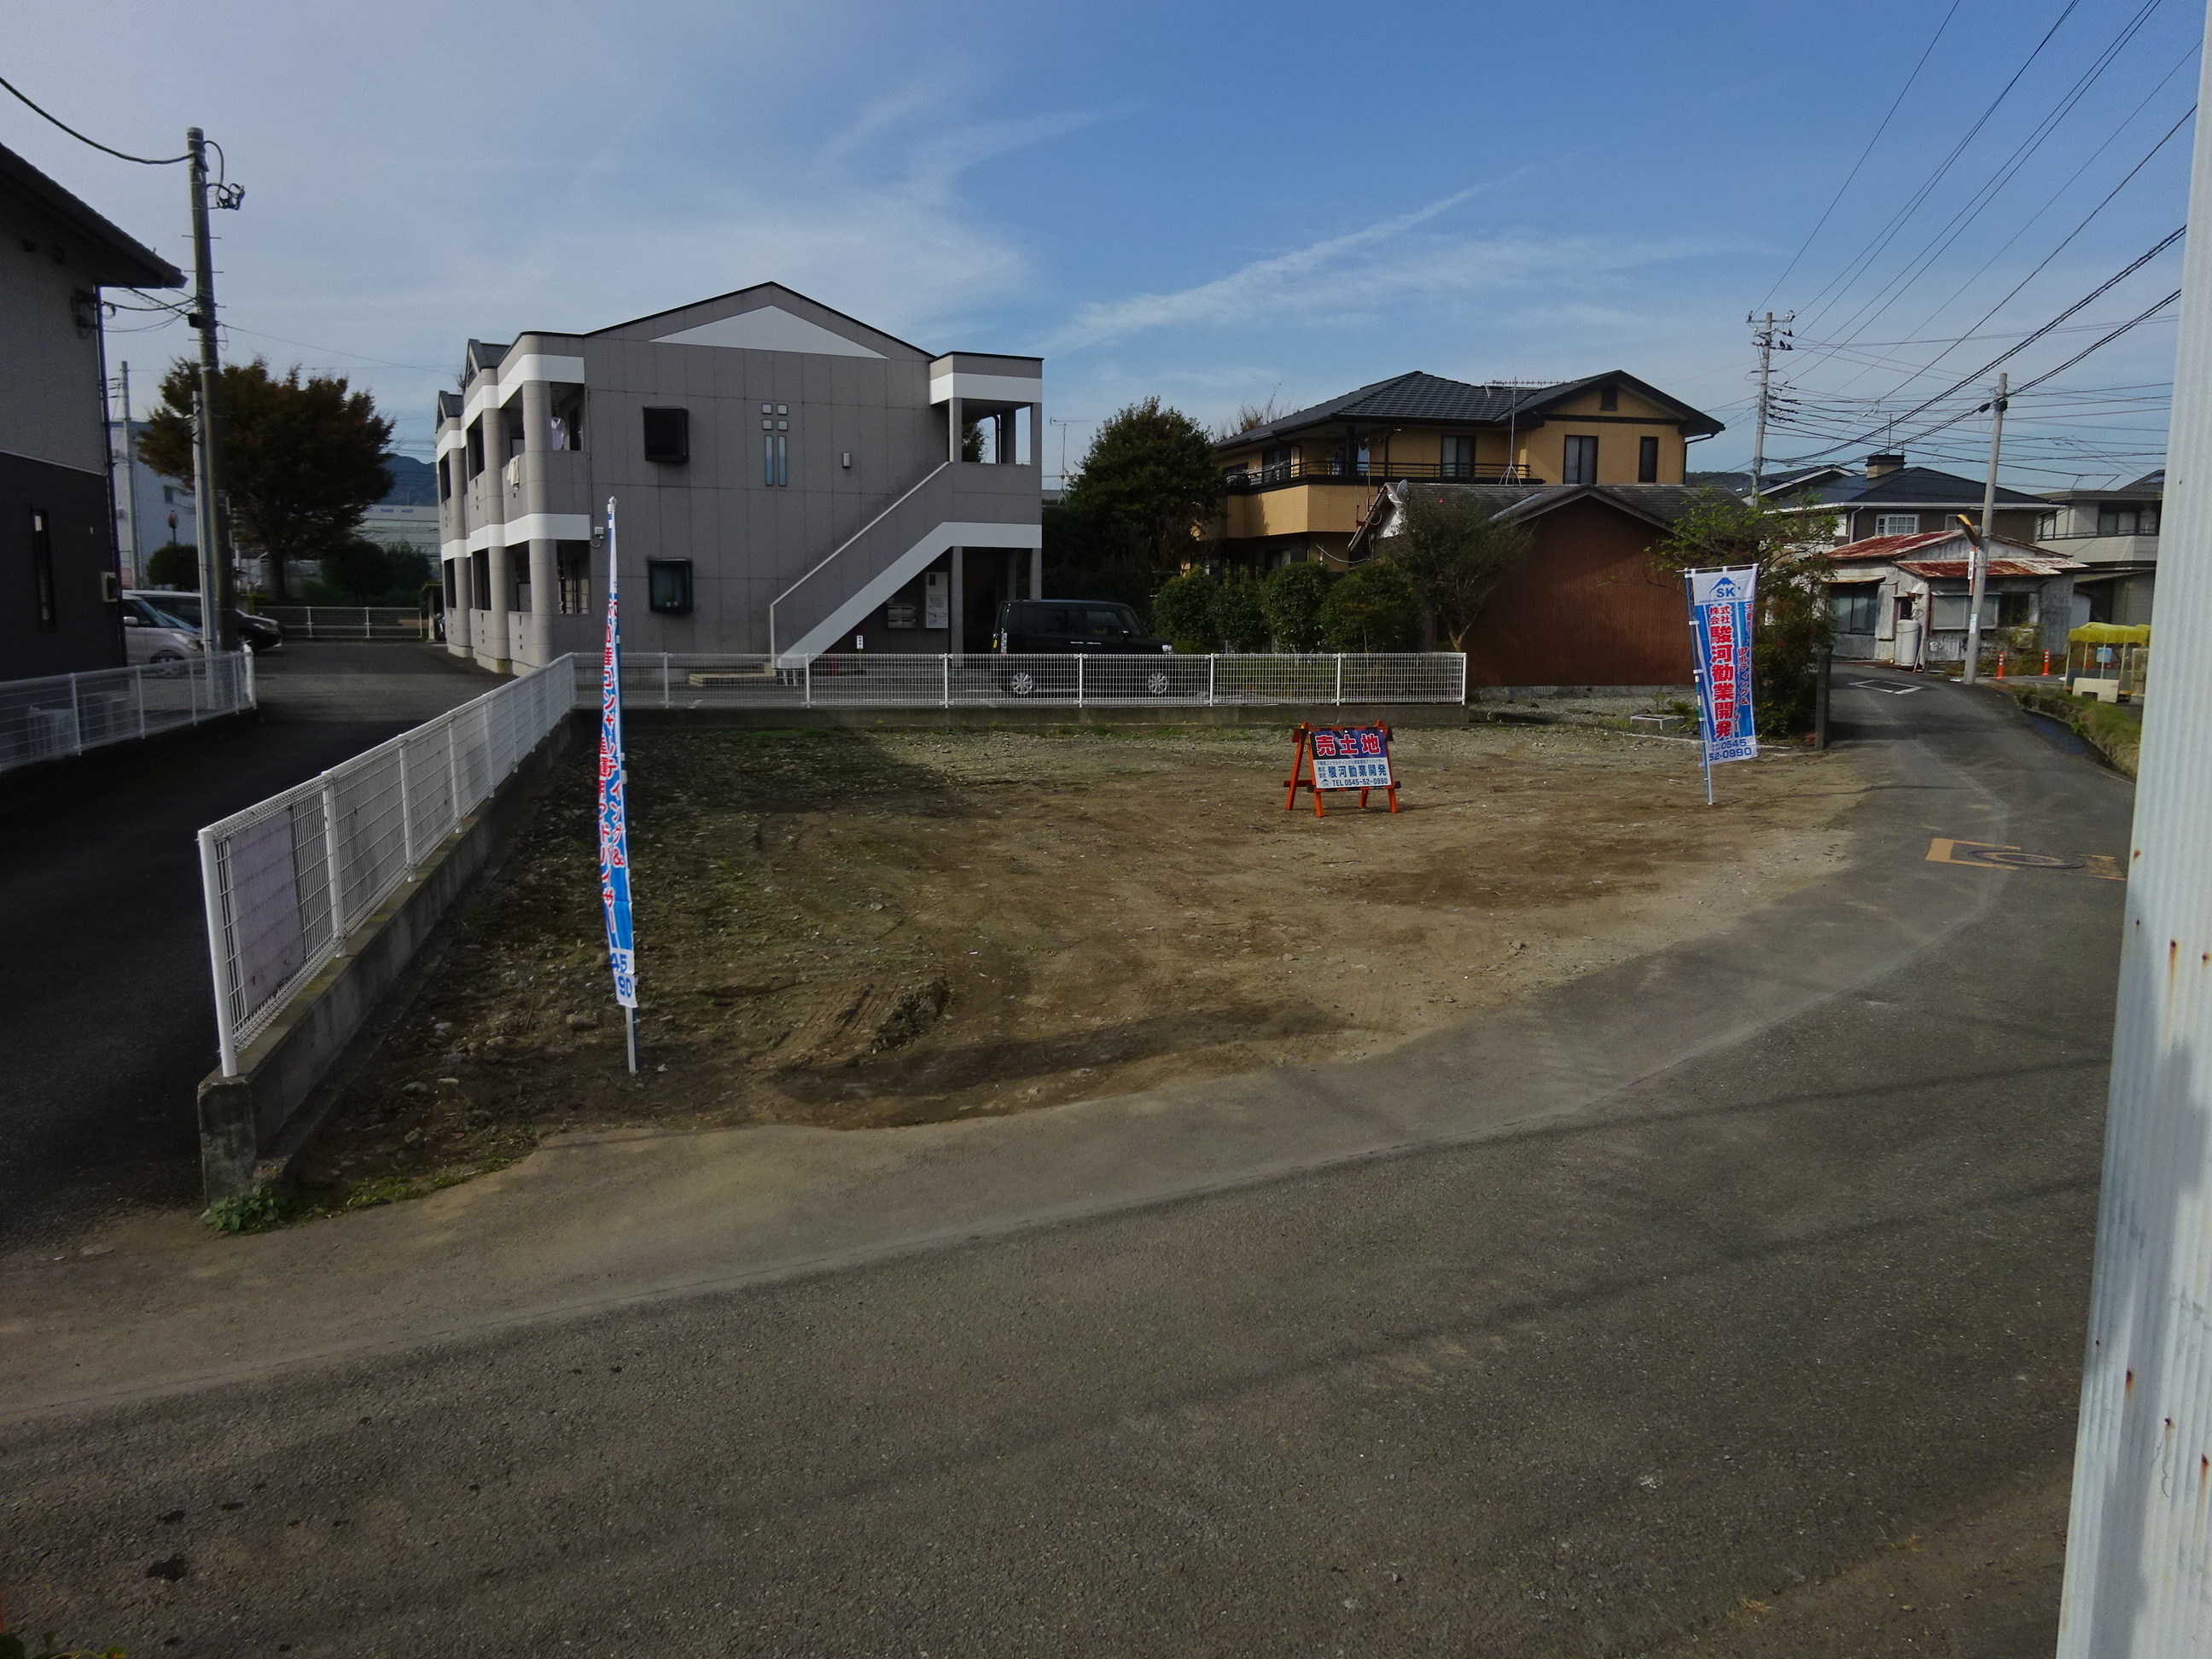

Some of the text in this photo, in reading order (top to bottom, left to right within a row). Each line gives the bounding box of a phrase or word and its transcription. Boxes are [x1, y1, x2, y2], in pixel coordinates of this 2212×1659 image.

[1716, 587, 1736, 597] SK
[1315, 734, 1380, 756] 売土地
[1721, 738, 1747, 749] 0545
[1708, 747, 1752, 761] 52-0990
[1345, 777, 1388, 786] 0545-52-0990
